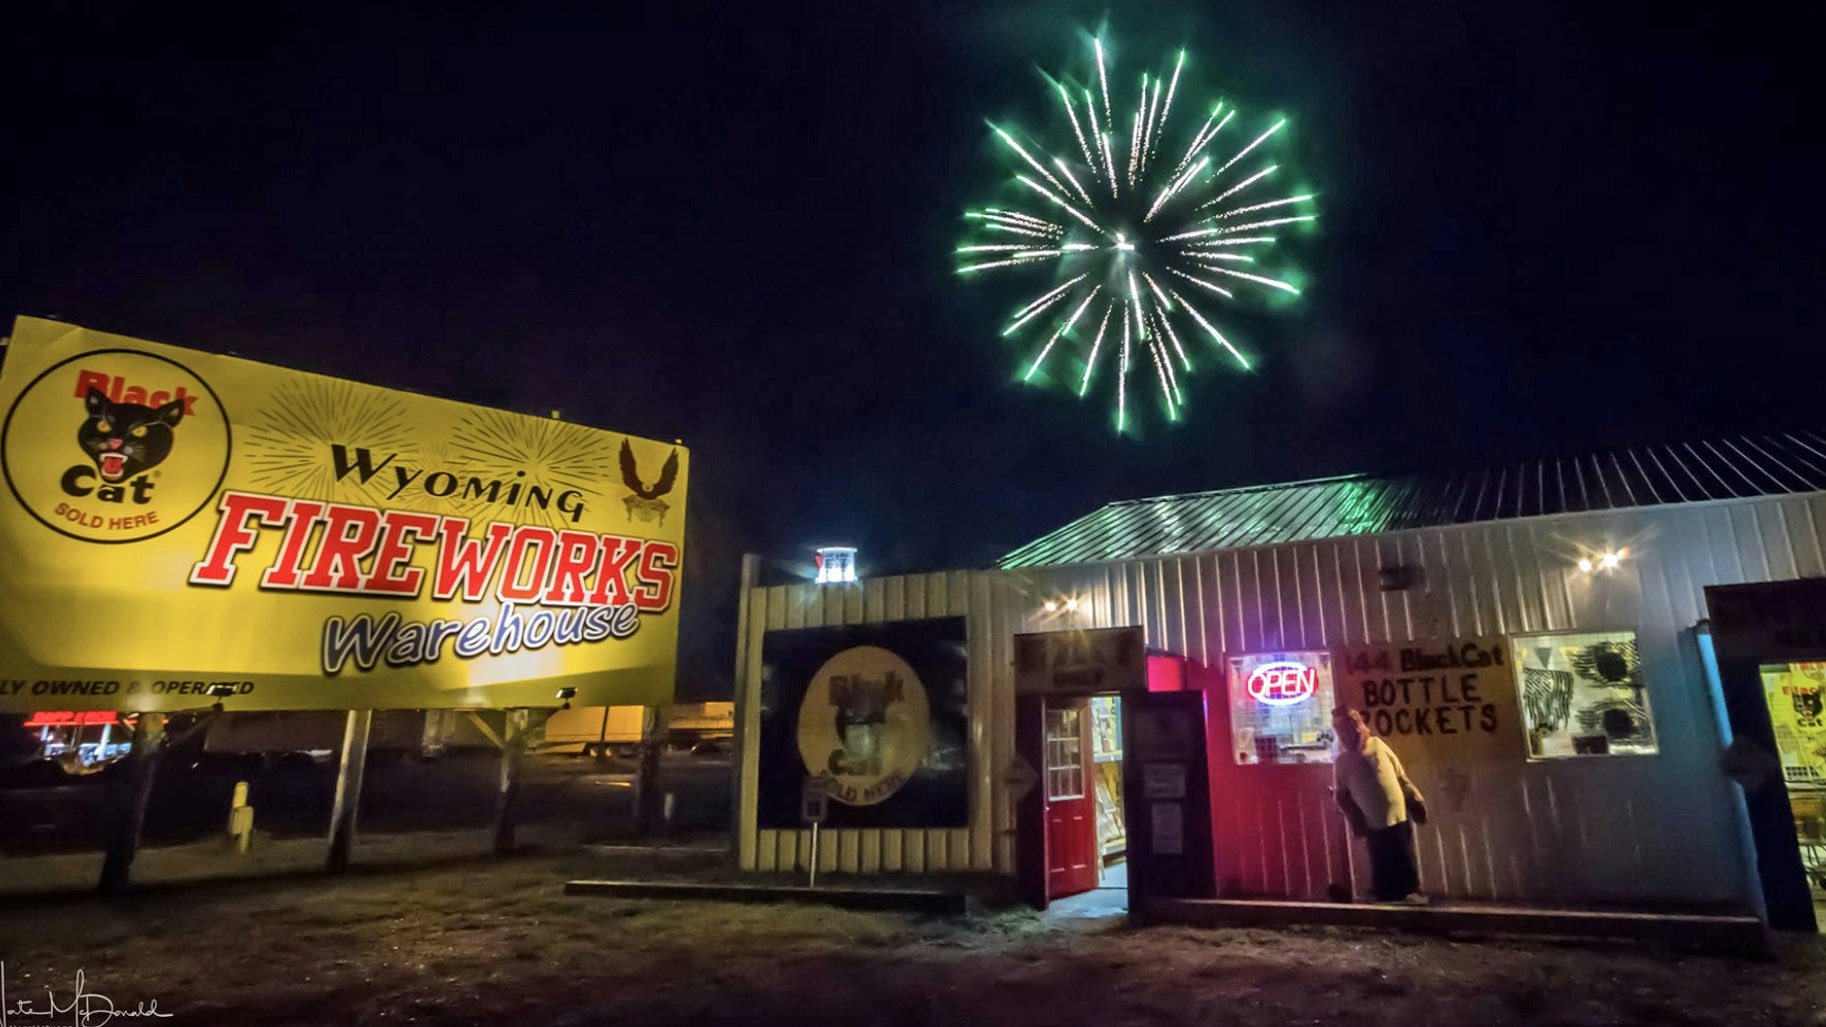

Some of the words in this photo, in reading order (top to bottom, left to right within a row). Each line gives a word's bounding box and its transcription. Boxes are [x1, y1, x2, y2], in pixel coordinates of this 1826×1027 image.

[74, 369, 198, 416] Black
[61, 464, 155, 505] Cat
[54, 502, 104, 529] SOLD
[109, 511, 160, 530] HERE
[188, 490, 680, 613] FIREWORKS
[321, 601, 642, 676] Warehouse
[31, 680, 120, 695] OWNED
[1247, 667, 1317, 698] OPEN
[1361, 673, 1481, 708] BOTTLE
